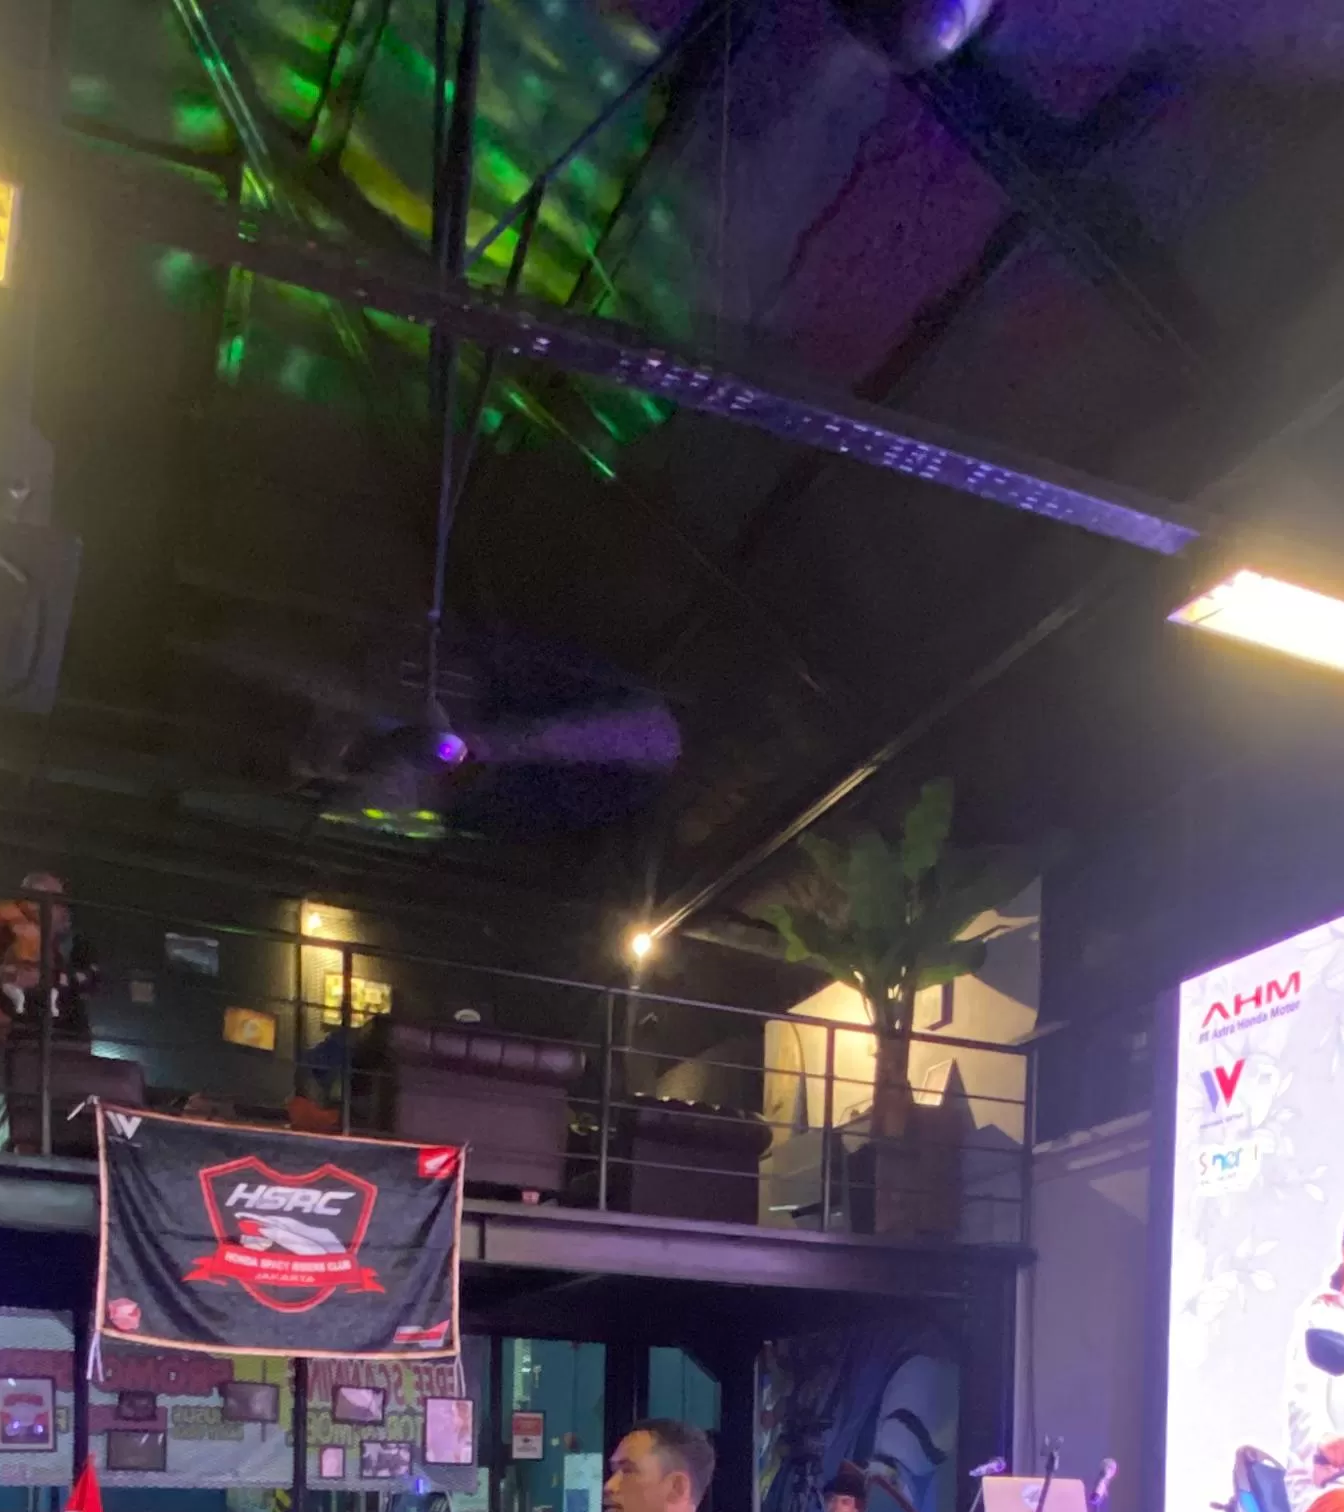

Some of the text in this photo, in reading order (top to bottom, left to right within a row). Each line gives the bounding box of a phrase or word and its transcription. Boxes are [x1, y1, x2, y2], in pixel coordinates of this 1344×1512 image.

[1200, 970, 1301, 1029] AHM
[1237, 1011, 1269, 1030] Honda
[1270, 999, 1301, 1019] Motor
[224, 1182, 356, 1216] HSRC
